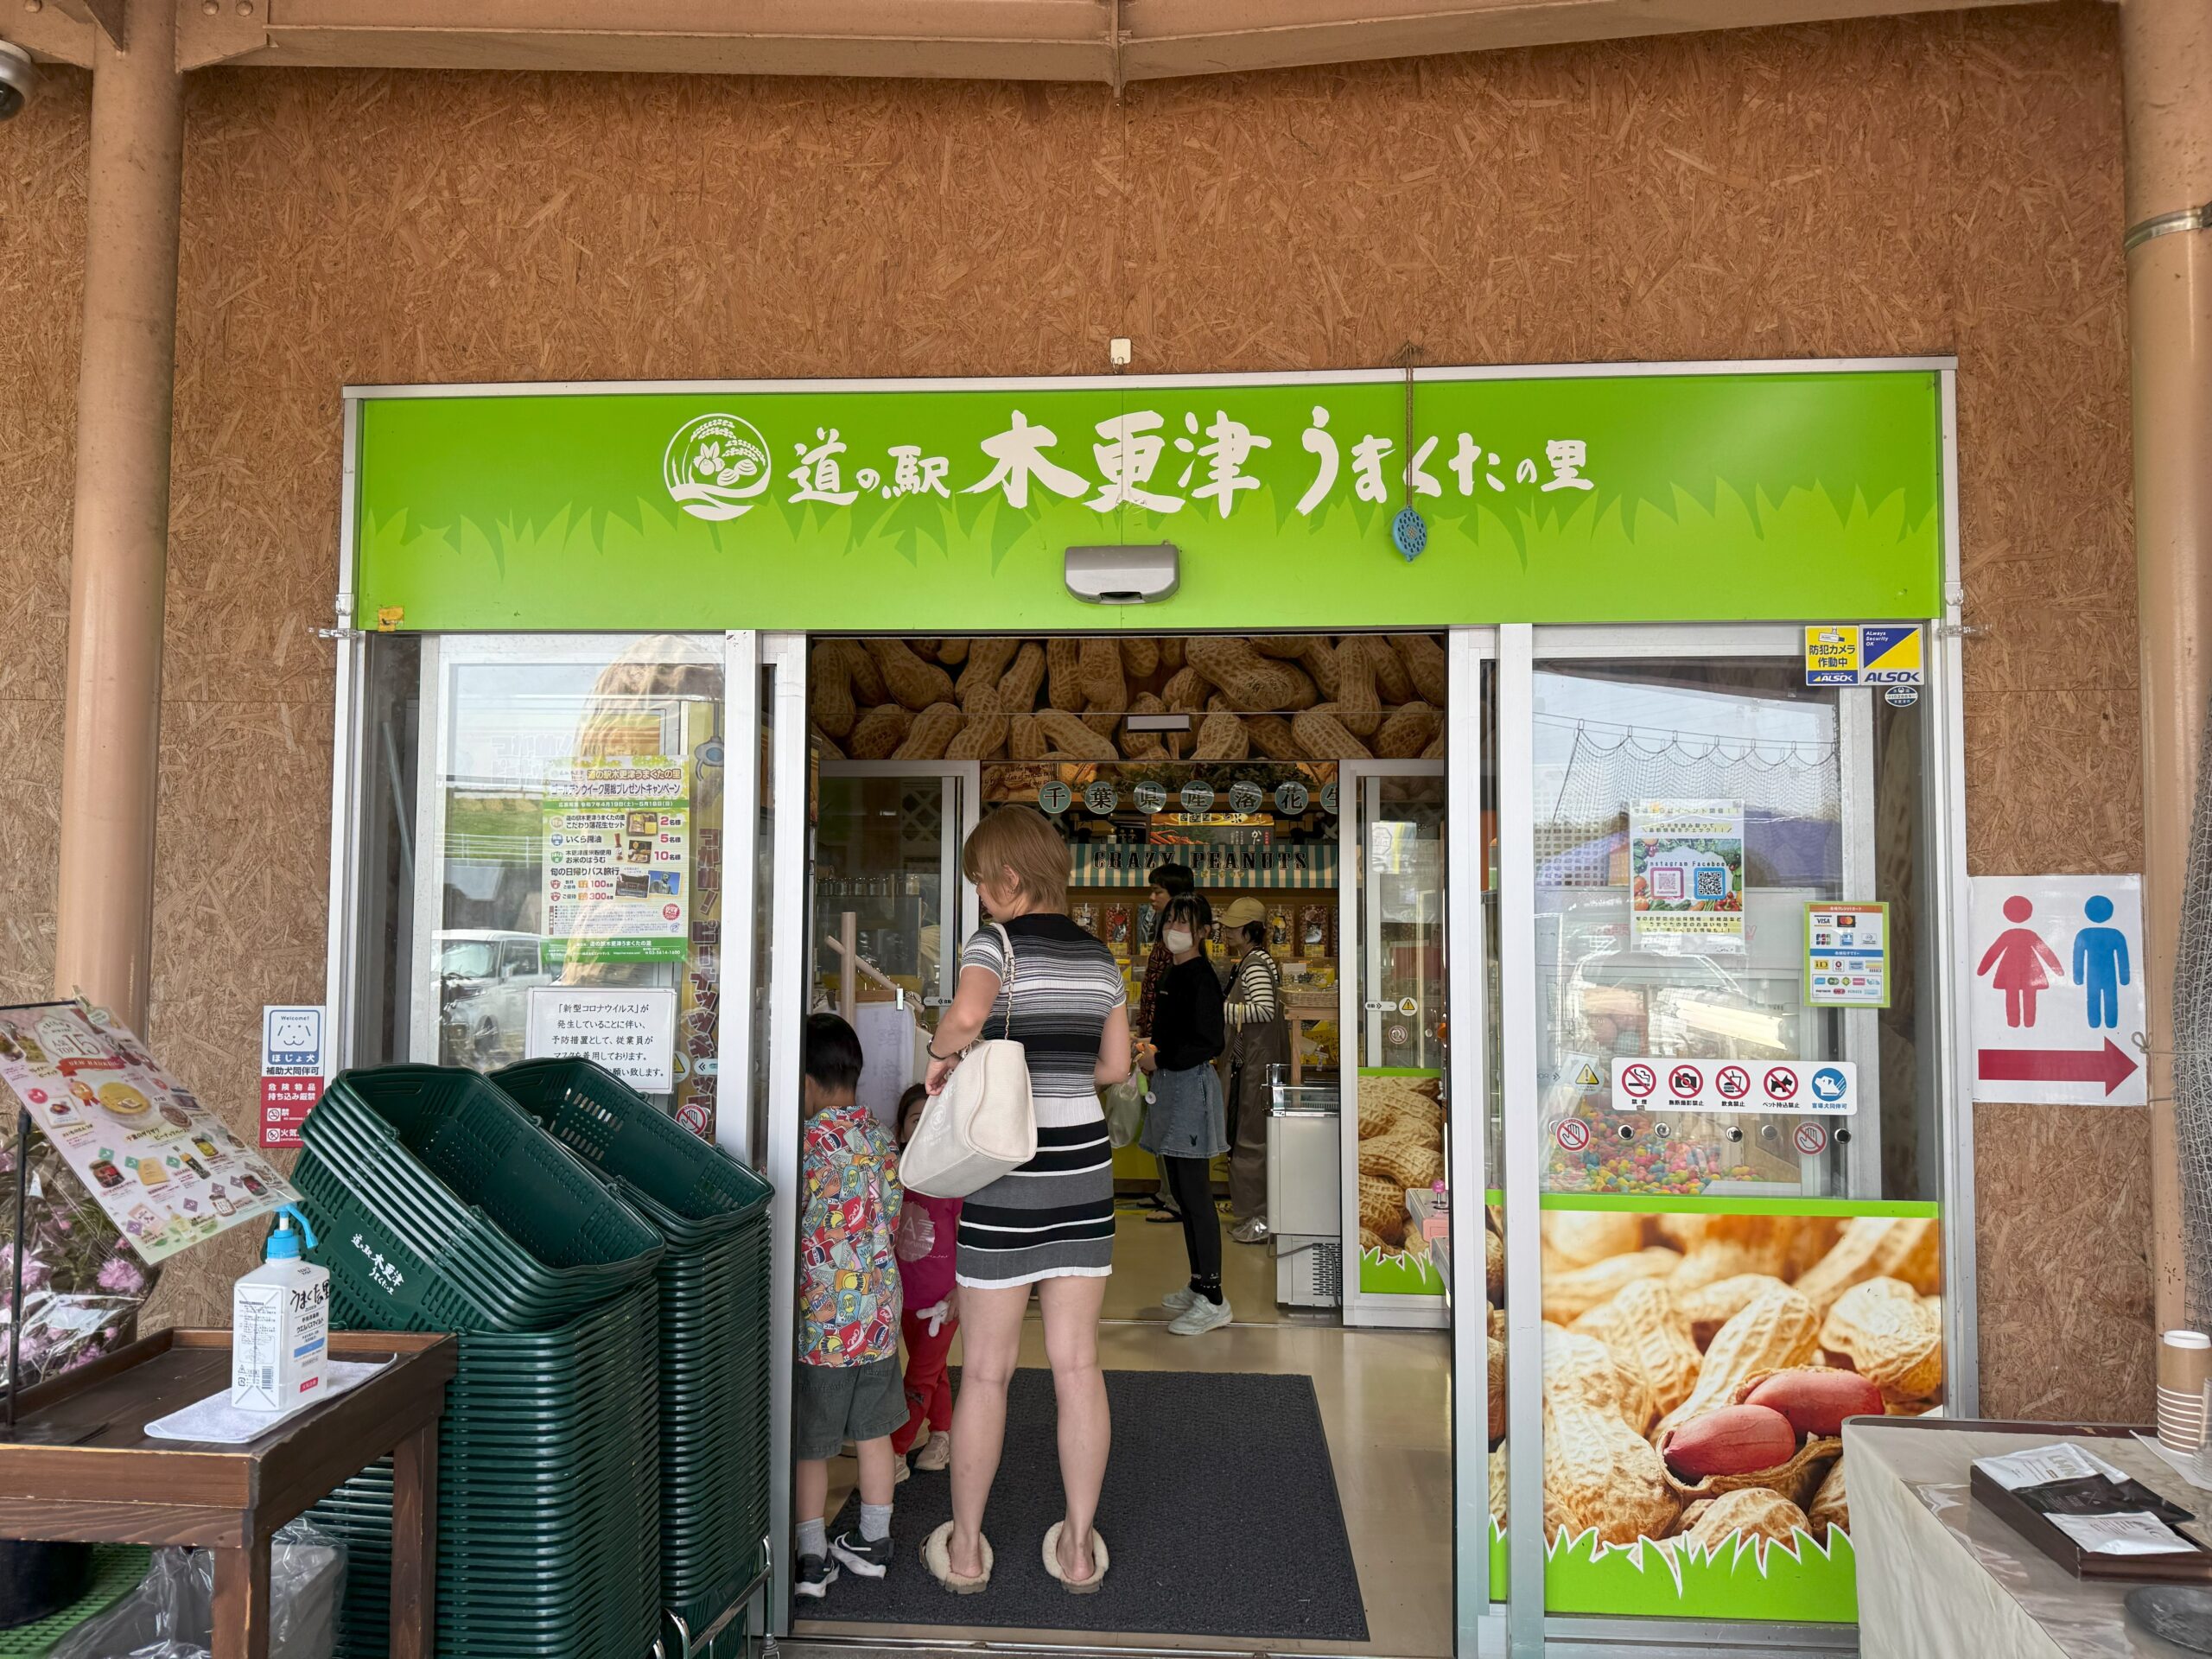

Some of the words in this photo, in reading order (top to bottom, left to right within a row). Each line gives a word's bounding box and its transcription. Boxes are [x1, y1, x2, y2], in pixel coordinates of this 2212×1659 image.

[788, 427, 950, 505] 道の駅
[957, 410, 1272, 518] 木更津
[1295, 405, 1595, 517] うまくたの里
[1808, 645, 1856, 656] 防犯カメラ
[1817, 657, 1848, 668] 作動中
[1864, 671, 1920, 683] ALSOK
[1093, 850, 1176, 870] CRAZY
[1191, 850, 1307, 870] PEANUTS
[557, 1004, 649, 1014] 「新型コロナウイルス」が
[557, 1020, 646, 1029] 発生していることに伴い、
[551, 1035, 653, 1046] 予防措置として、従業員が
[271, 1054, 315, 1063] ほじょ犬
[266, 1066, 320, 1076] 補助犬同伴可
[268, 1083, 316, 1091] 危険物品
